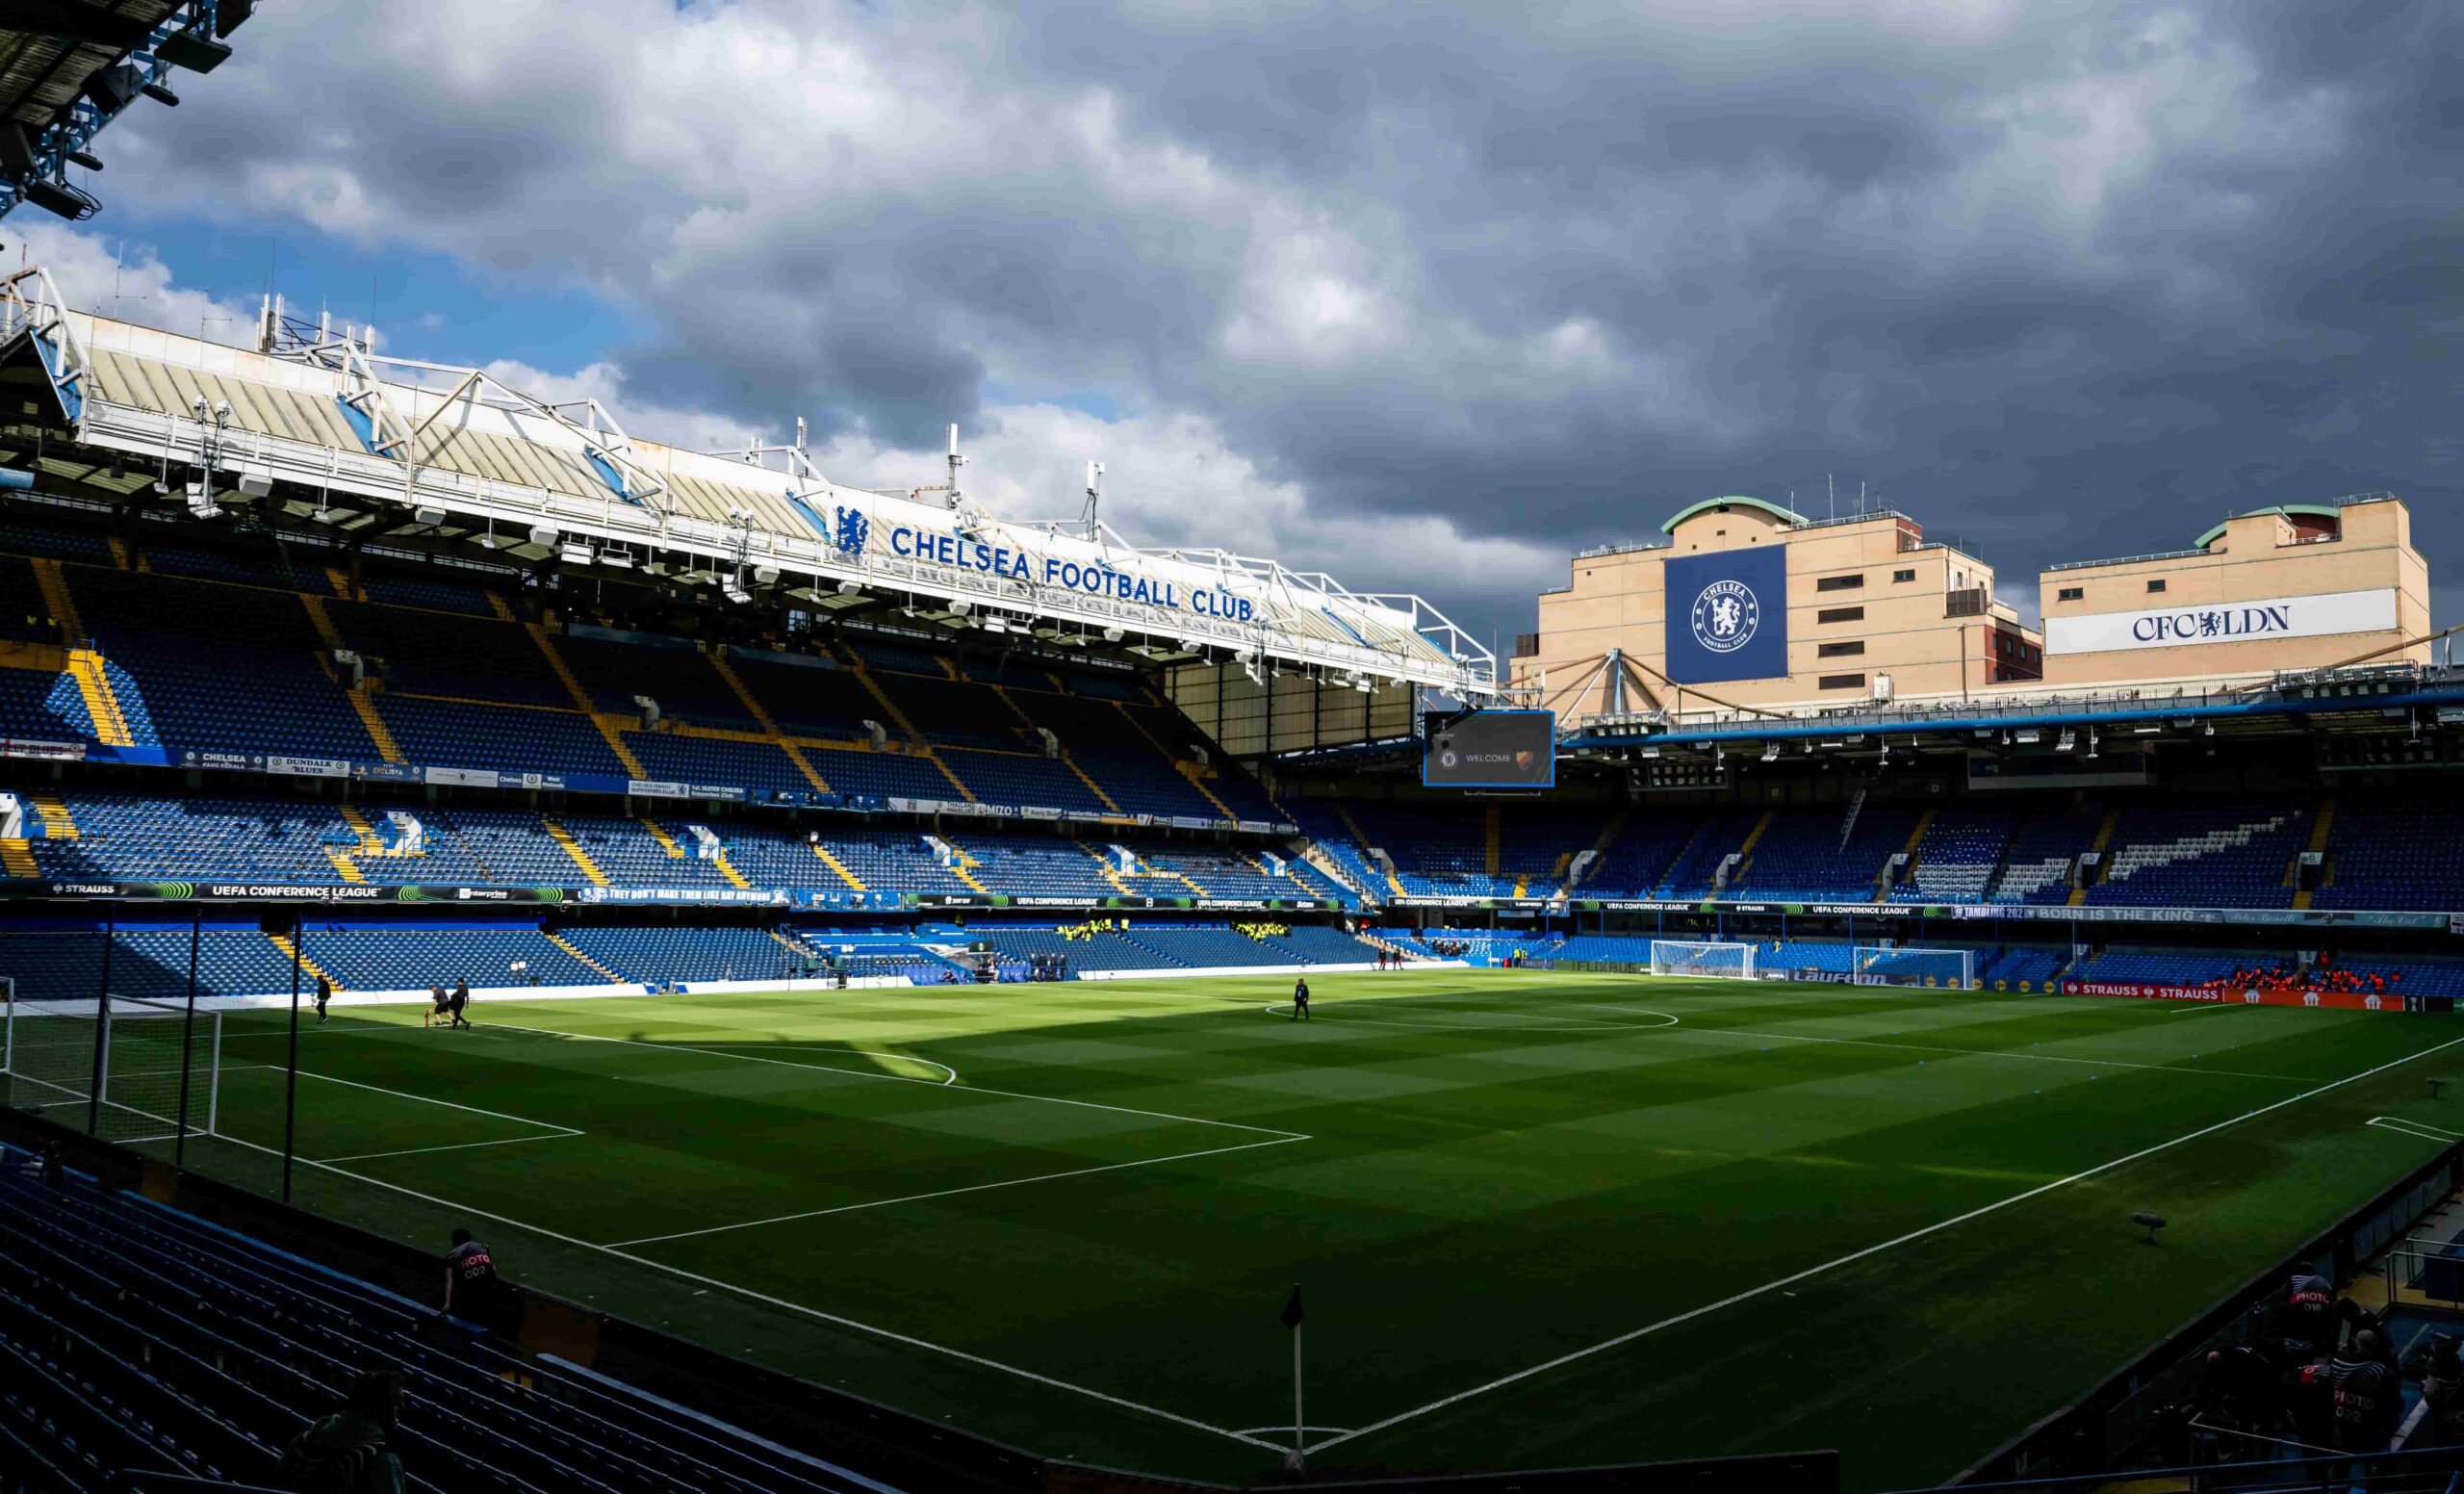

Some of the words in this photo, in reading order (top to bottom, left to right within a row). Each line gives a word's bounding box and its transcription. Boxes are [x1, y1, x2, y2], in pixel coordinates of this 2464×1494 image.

[891, 528, 1031, 580] CHELSEA
[1047, 558, 1180, 608] FOOTBALL
[1193, 590, 1253, 621] CLUB
[1703, 583, 1746, 601] CHELSEA
[2133, 616, 2198, 641] CFC
[2221, 605, 2292, 634] LDN
[1703, 636, 1732, 649] FOOTBALL
[1732, 632, 1748, 645] CLUB
[202, 753, 246, 762] CHELSEA
[286, 759, 332, 768] DUNDALK
[987, 806, 1014, 816] MIZO
[64, 885, 115, 894] STRAUSS
[213, 886, 247, 896] UEFA
[249, 886, 330, 897] CONFERENCE
[609, 889, 630, 899] THEY
[631, 889, 655, 899] DON'T
[657, 889, 680, 900] MAKE
[680, 889, 703, 900] THEM
[704, 889, 721, 900] LIKE
[722, 890, 736, 901] RAY
[736, 890, 771, 901] ANYMORE
[1016, 897, 1034, 906] UEFA
[1035, 897, 1074, 906] CONFERENCE
[1211, 899, 1244, 908] CONFERENCE
[1812, 905, 1832, 914] UEFA
[1833, 906, 1880, 914] CONFERENCE
[1964, 907, 2006, 918] TAMBLING
[2006, 907, 2023, 918] 202
[2039, 908, 2084, 920] BORN
[2090, 909, 2105, 920] IS
[2112, 909, 2145, 920] THE
[2152, 909, 2195, 921] KING
[1577, 961, 1636, 974] FLIXBUS
[2083, 984, 2139, 996] STRAUSS
[2160, 988, 2219, 1000] STRAUSS
